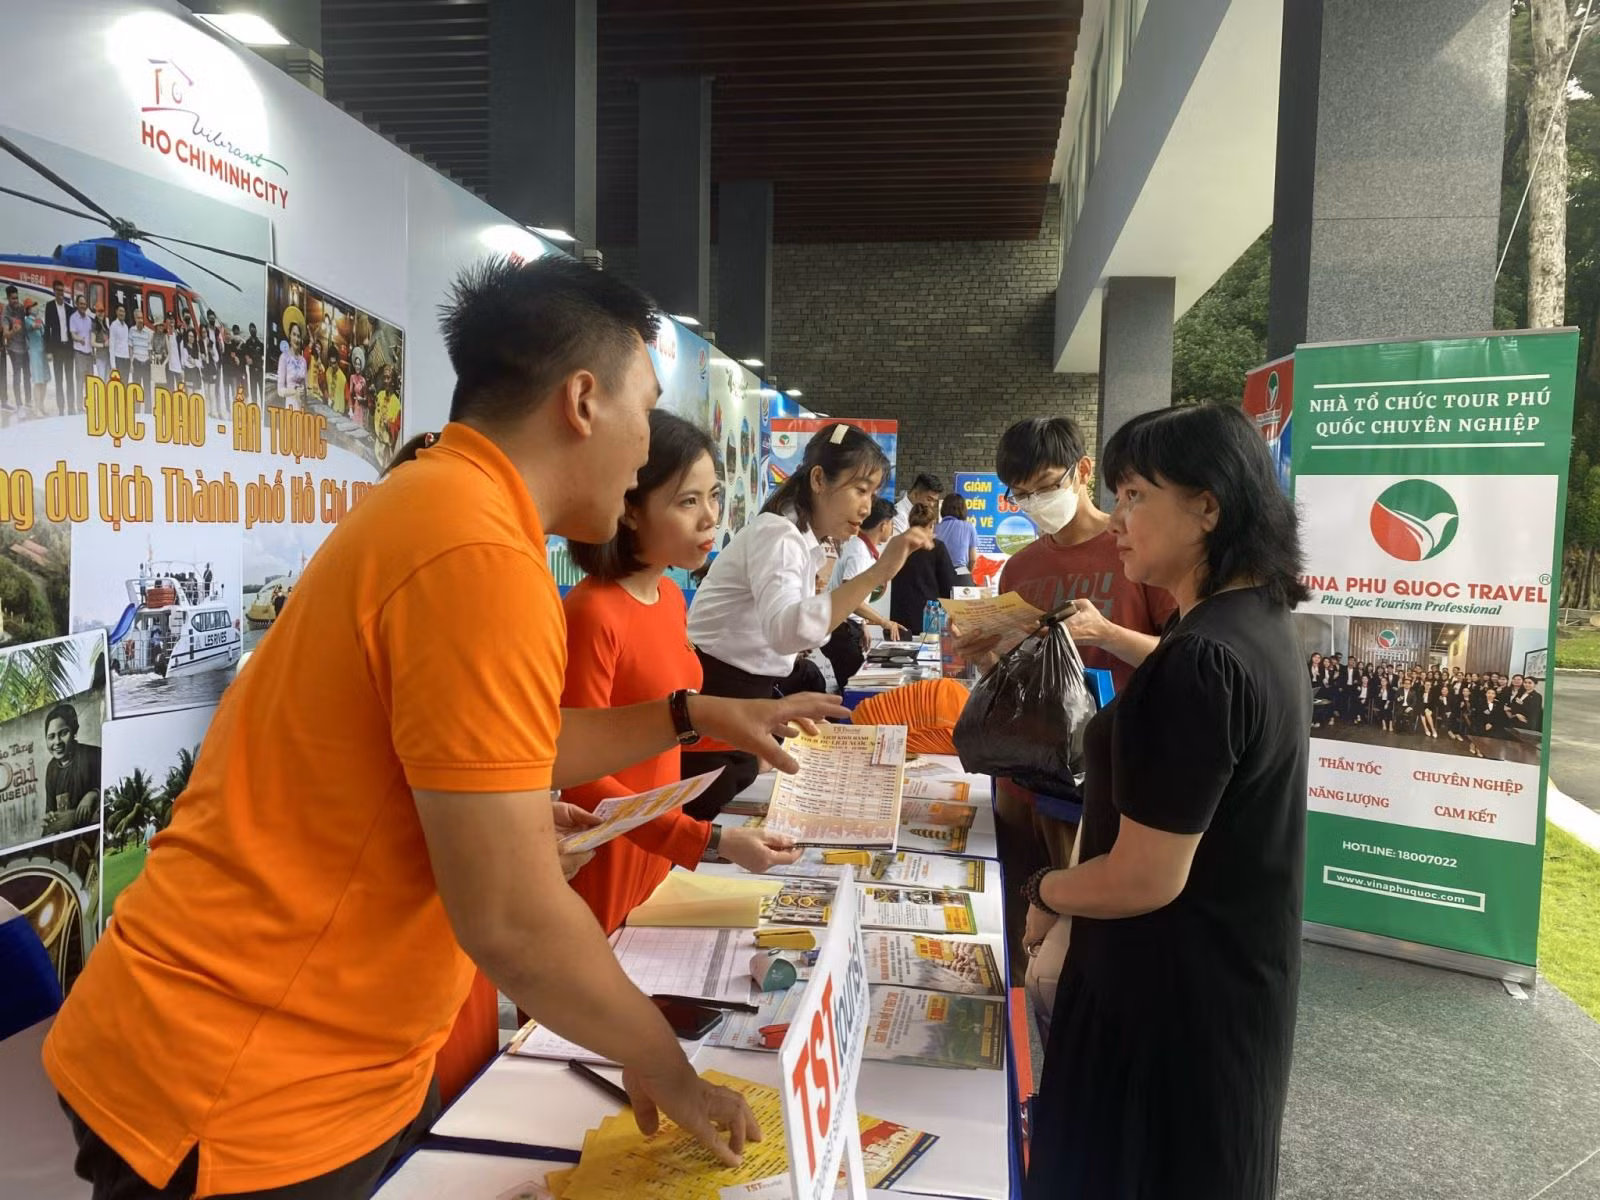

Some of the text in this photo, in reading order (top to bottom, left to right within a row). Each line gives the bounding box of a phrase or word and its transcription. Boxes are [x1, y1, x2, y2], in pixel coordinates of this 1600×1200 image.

[141, 120, 289, 210] HO CHI MINH CITY
[1309, 386, 1552, 413] NHÀ TỔ CHỨC TOUR PHÚ
[84, 369, 145, 447] ĐỘC
[153, 382, 206, 447] ĐÁO
[267, 404, 328, 464] TƯỢNG
[1315, 412, 1540, 437] QUỐC CHUYÊN NGHIỆP
[46, 460, 89, 522] du
[98, 462, 153, 531] lịch
[161, 467, 239, 523] Thành
[245, 469, 286, 529] phố
[290, 471, 316, 523] Hồ
[1346, 577, 1387, 594] PHU
[1393, 579, 1460, 598] QUOC
[1467, 583, 1548, 603] TRAVEL
[1320, 594, 1502, 615] Phu Quoc Tourism Professional
[1356, 760, 1382, 776] TỐC
[1413, 770, 1470, 787] CHUYÊN
[1308, 785, 1390, 808] NĂNG LƯỢNG
[1433, 805, 1497, 824] CAM KẾT
[1342, 840, 1458, 868] HOTLINE: 18007022
[1336, 873, 1465, 904] www.vinaphuquoc.com
